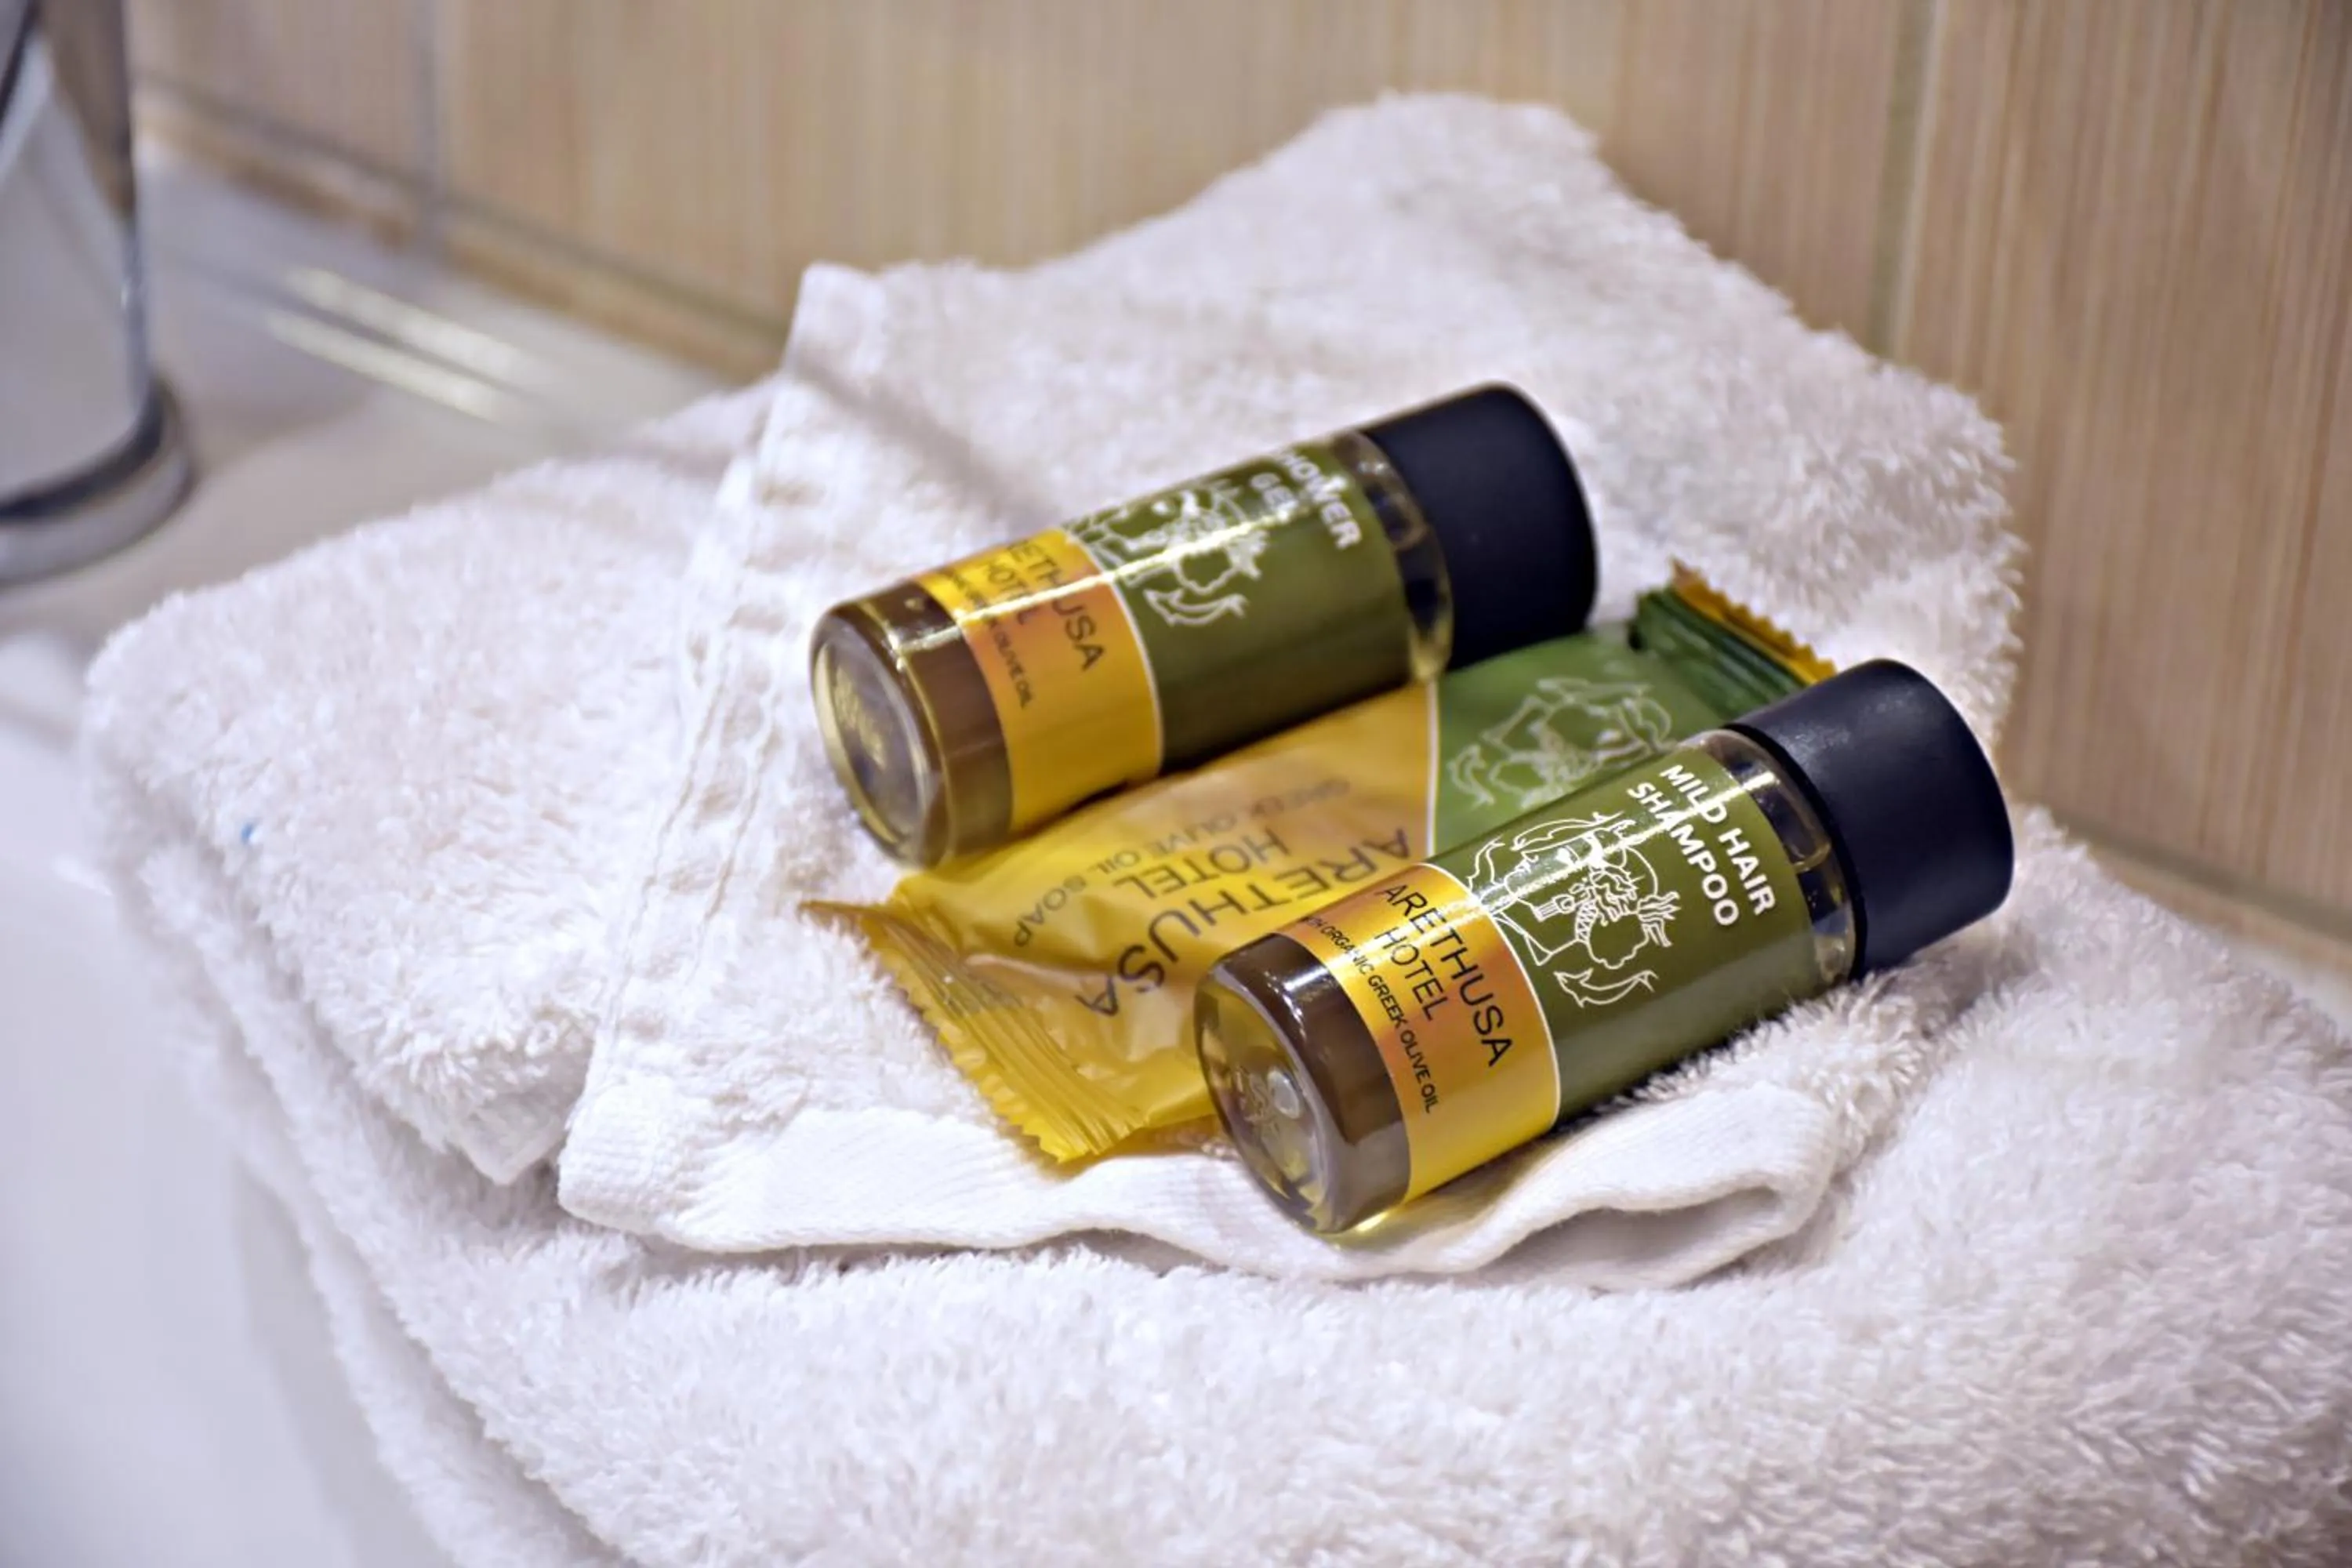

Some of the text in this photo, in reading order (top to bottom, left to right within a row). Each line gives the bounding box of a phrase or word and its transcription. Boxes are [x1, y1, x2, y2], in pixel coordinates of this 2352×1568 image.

[1089, 849, 1141, 876] OIL
[1112, 827, 1291, 899] HOTEL
[1151, 812, 1239, 856] OLIVE
[1627, 782, 1740, 926] SHAMPOO
[1659, 764, 1776, 916] MILD HAIR
[1014, 874, 1087, 948] SOAP
[1075, 828, 1410, 1017] ARETHUSA
[1372, 884, 1513, 1067] ARETHUSA
[1374, 926, 1448, 1021] HOTEL
[1368, 975, 1408, 1029] GREEK
[1400, 1029, 1431, 1083] OLIVE
[1421, 1083, 1439, 1113] OIL
